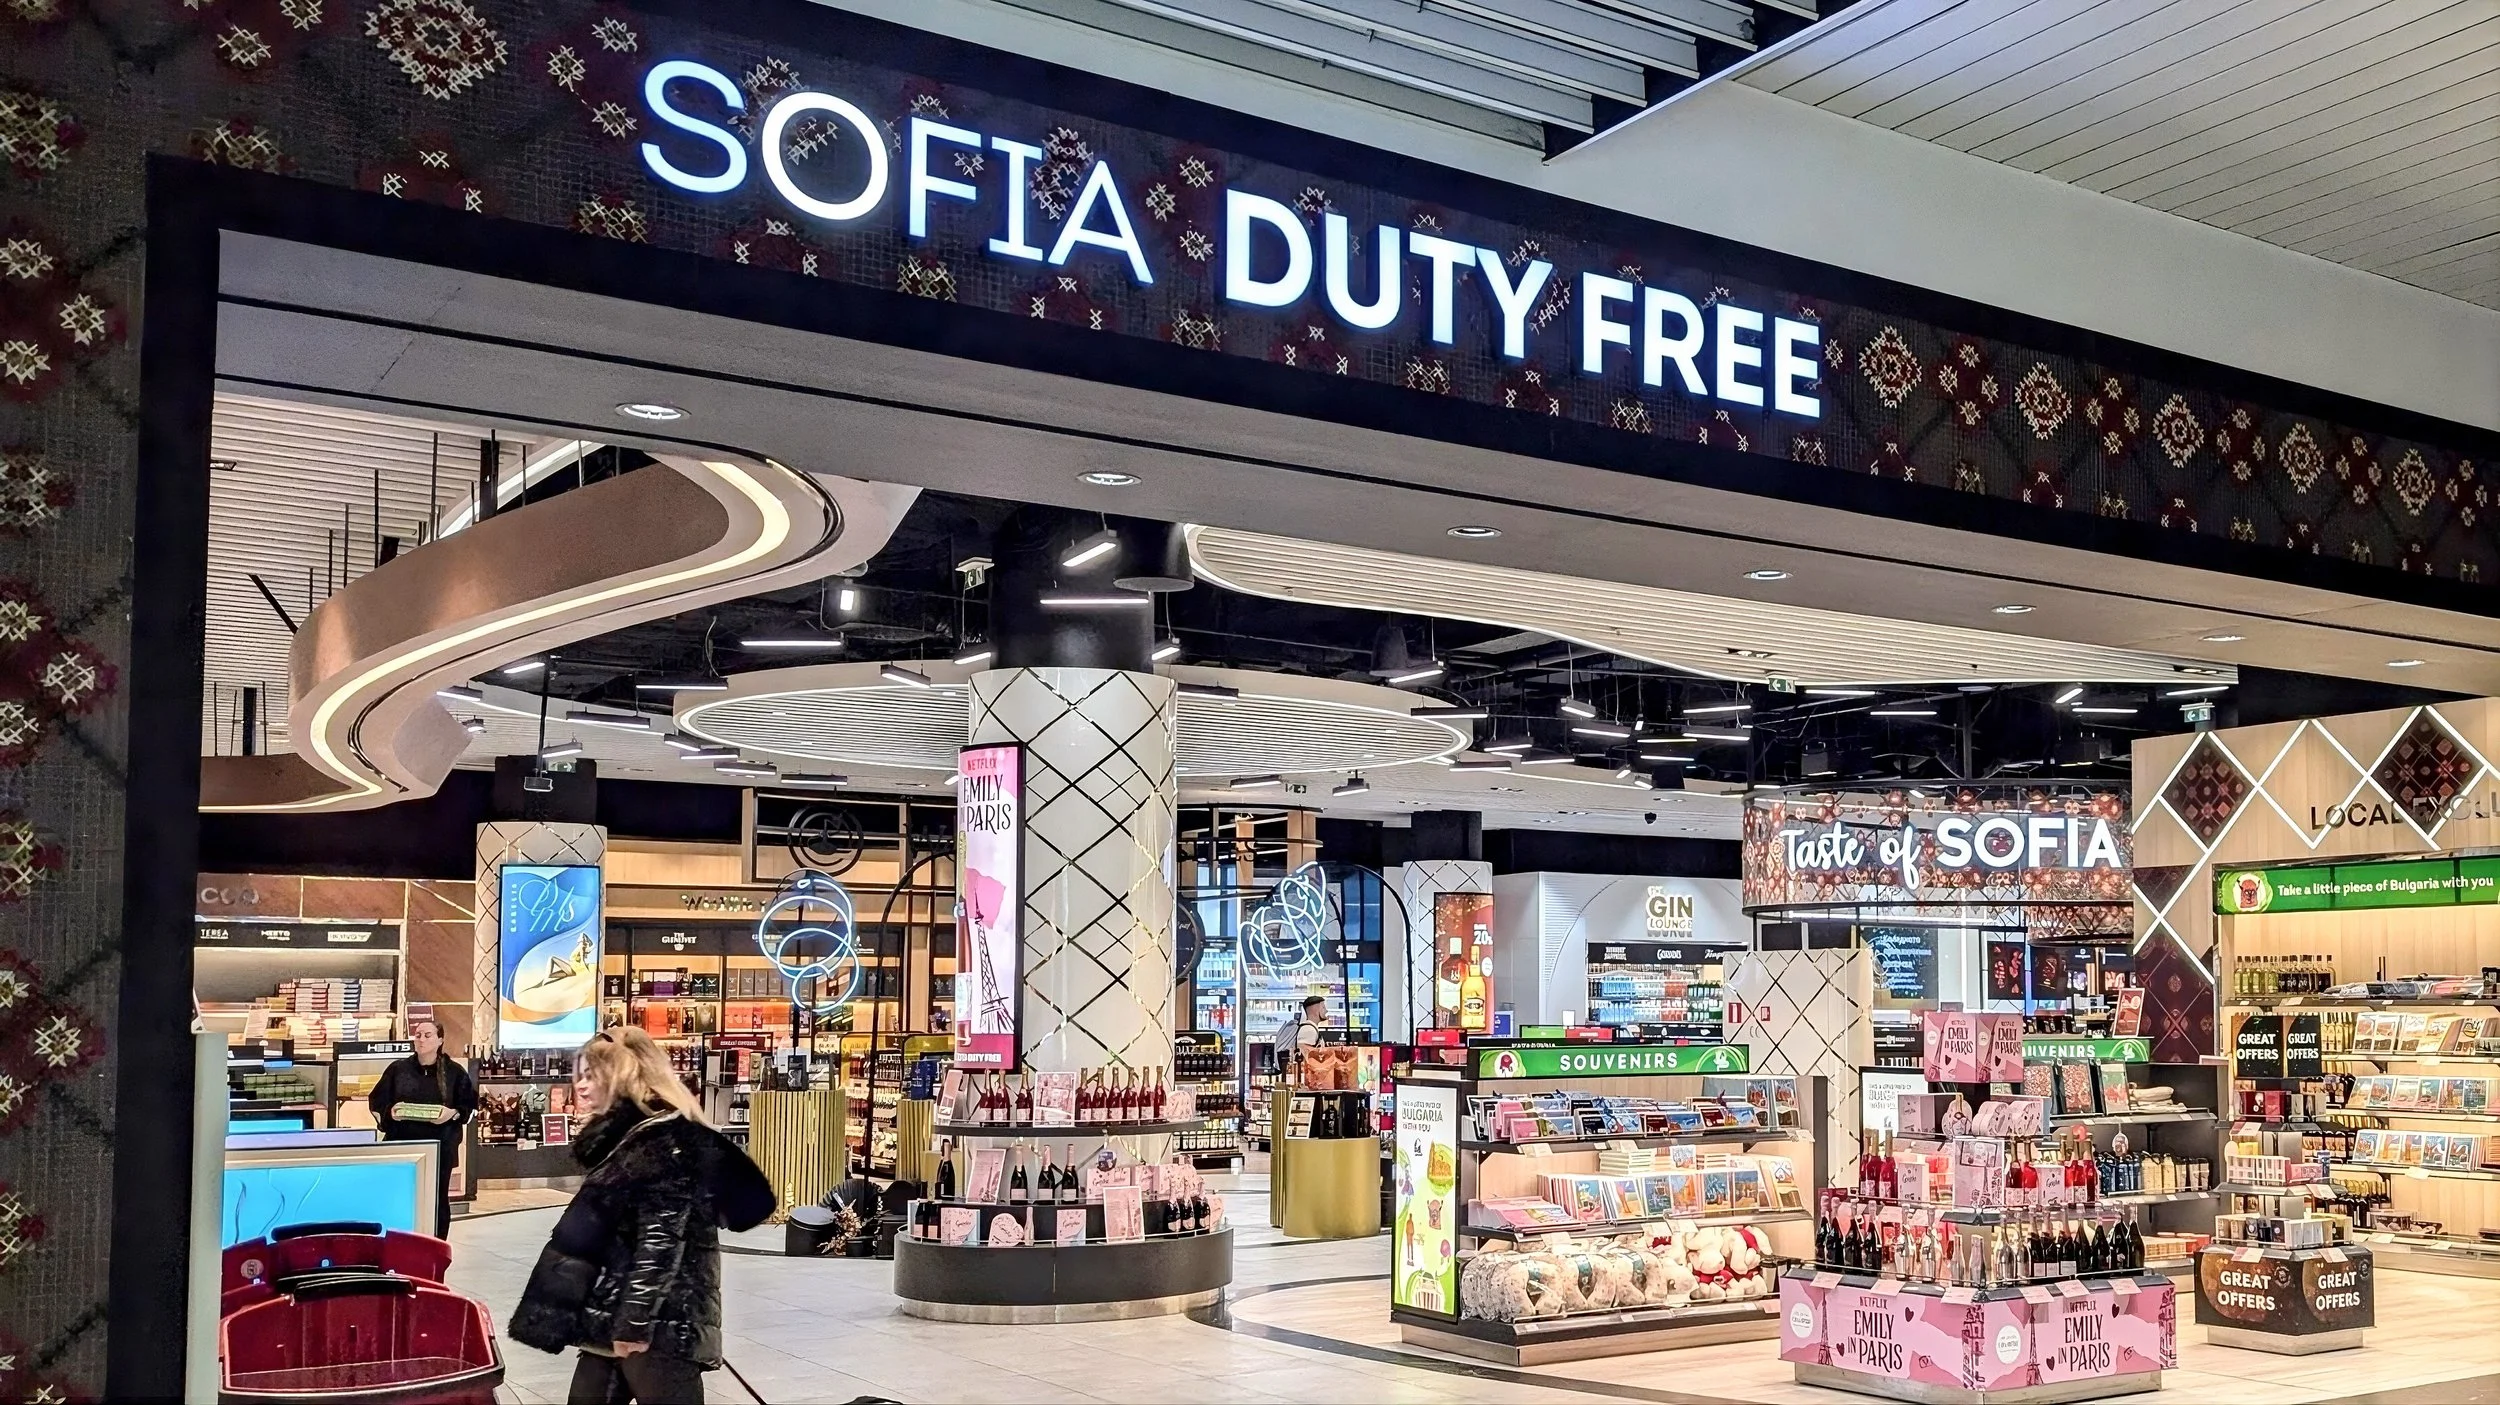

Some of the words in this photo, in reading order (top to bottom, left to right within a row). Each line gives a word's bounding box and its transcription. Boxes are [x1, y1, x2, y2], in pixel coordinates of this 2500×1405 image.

[640, 59, 1154, 285] SOFIA
[1226, 188, 1554, 359] DUTY
[1582, 271, 1821, 419] FREE
[963, 773, 1003, 804] EMILY
[966, 803, 1012, 835] PARIS
[2310, 799, 2405, 831] LOCAL
[1779, 822, 1866, 880] Taste
[1879, 825, 1922, 890] of
[1935, 817, 2123, 868] SOFIA
[2277, 884, 2303, 897] Take
[2303, 886, 2312, 896] a
[2313, 881, 2341, 895] little
[2343, 882, 2373, 897] piece
[2375, 879, 2388, 892] of
[2389, 877, 2440, 894] Bulgaria
[2441, 875, 2468, 890] with
[2470, 876, 2495, 891] you
[1648, 896, 1694, 919] GIN
[1648, 918, 1694, 931] LOUNGE
[2237, 1033, 2277, 1045] GREAT
[2287, 1032, 2317, 1045] GREAT
[1559, 1052, 1678, 1071] SOUVENIRS
[2021, 1044, 2096, 1058] UVENIRS
[2236, 1047, 2279, 1060] OFFERS
[2286, 1047, 2319, 1059] OFFERS
[2219, 1270, 2272, 1290] GREAT
[2317, 1271, 2358, 1290] GREAT
[1859, 1295, 1888, 1310] NETFLIX
[2217, 1290, 2276, 1311] OFFERS
[2315, 1291, 2361, 1311] OFFERS
[1854, 1309, 1895, 1341] EMILY
[2064, 1314, 2104, 1344] EMILY
[1847, 1335, 1857, 1354] IN
[1858, 1337, 1903, 1373] PARIS
[2057, 1347, 2067, 1365] IN
[2069, 1341, 2111, 1374] PARIS
